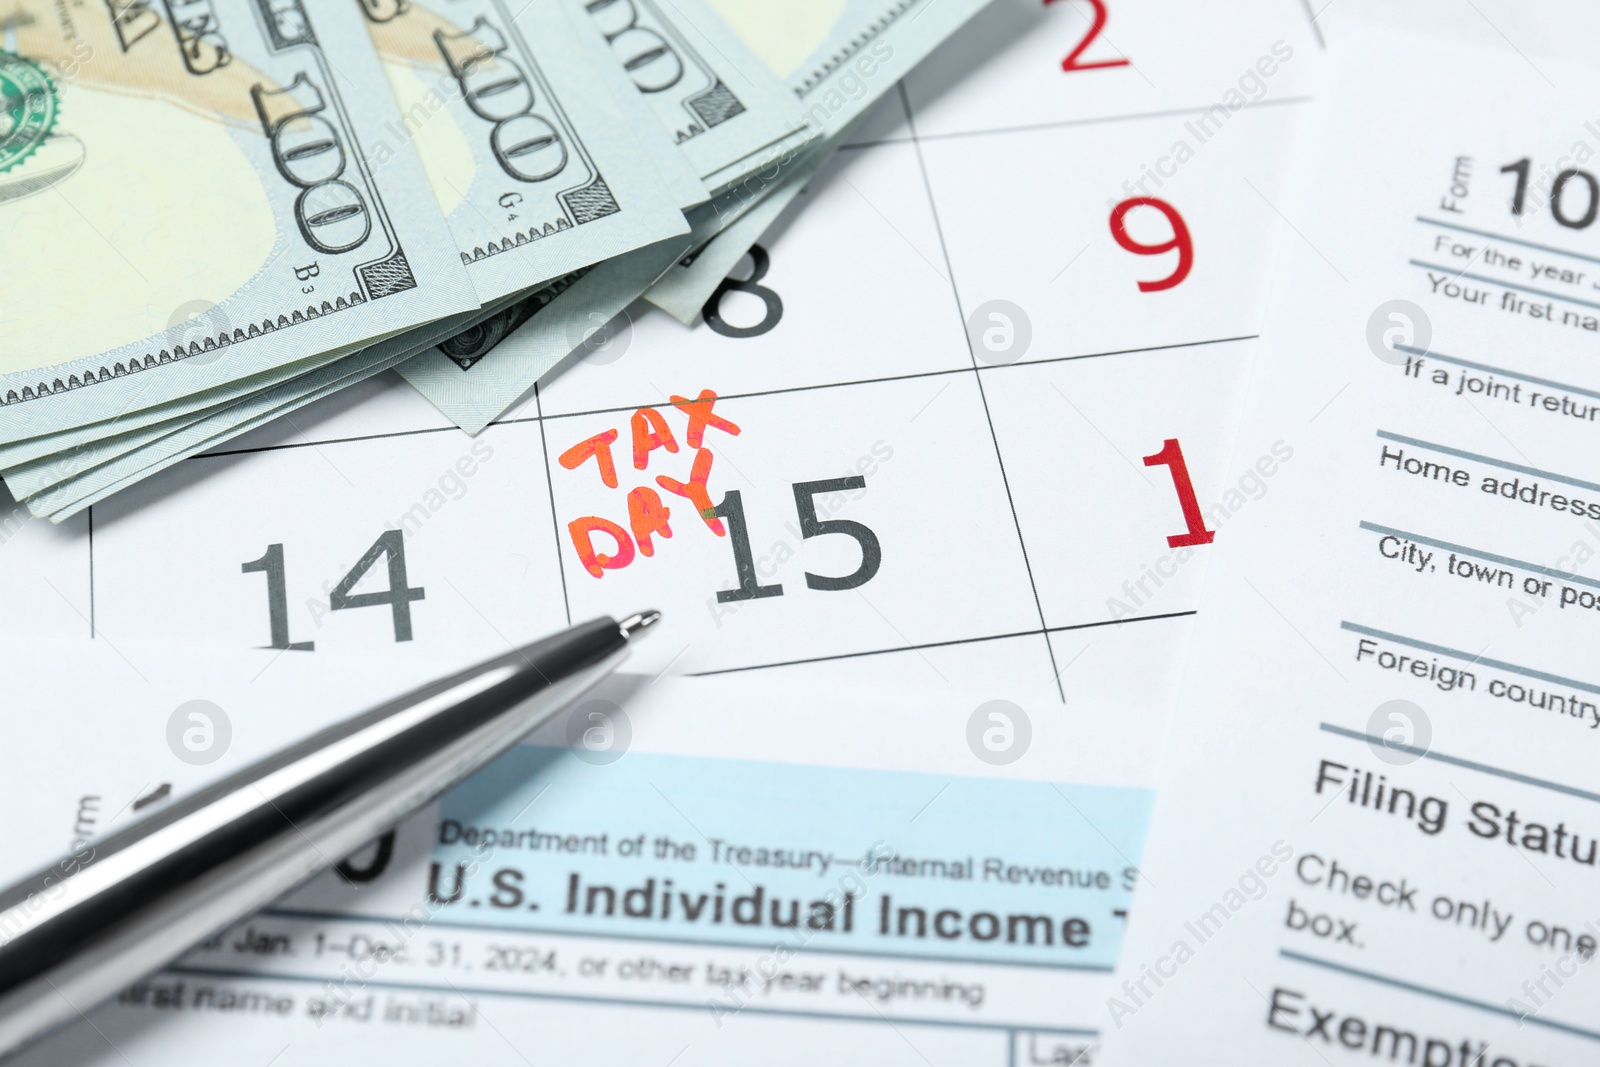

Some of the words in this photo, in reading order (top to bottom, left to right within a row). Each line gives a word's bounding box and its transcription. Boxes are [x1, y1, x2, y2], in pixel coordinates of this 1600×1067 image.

[1041, 0, 1132, 72] 2
[432, 15, 569, 182] 100
[250, 72, 371, 255] 100
[1440, 155, 1474, 213] Form
[1500, 157, 1600, 230] 10
[1109, 196, 1194, 292] 9
[1434, 235, 1478, 260] For
[1484, 247, 1522, 271] the
[1531, 261, 1586, 285] year
[702, 243, 783, 338] 8
[1427, 272, 1490, 306] Your
[1501, 291, 1554, 321] first
[1405, 357, 1425, 378] If
[1432, 369, 1449, 386] a
[1455, 370, 1522, 403] joint
[558, 389, 741, 489] TAX
[568, 447, 726, 579] DAY
[1380, 445, 1470, 486] Home
[1481, 477, 1600, 520] address
[702, 475, 882, 603] 15
[1379, 535, 1436, 573] City,
[1448, 553, 1514, 589] town
[1524, 577, 1552, 597] or
[242, 529, 425, 652] 14
[1356, 638, 1476, 691] Foreign
[1489, 679, 1600, 729] country
[437, 820, 608, 856] Department
[617, 834, 646, 859] of
[654, 838, 697, 863] the
[982, 857, 1111, 891] Revenue
[1314, 759, 1449, 836] Filing
[1467, 800, 1597, 866] Statu
[427, 862, 539, 911] U.S.
[564, 872, 856, 930] Individual
[877, 894, 1092, 948] Income
[1285, 899, 1365, 949] box.
[1296, 853, 1418, 912] Check
[1432, 895, 1513, 941] only
[1526, 920, 1598, 960] one
[192, 986, 294, 1017] name
[578, 956, 607, 978] or
[616, 958, 694, 984] other
[706, 962, 754, 986] tax
[757, 968, 826, 999] year
[838, 969, 986, 1011] beginning
